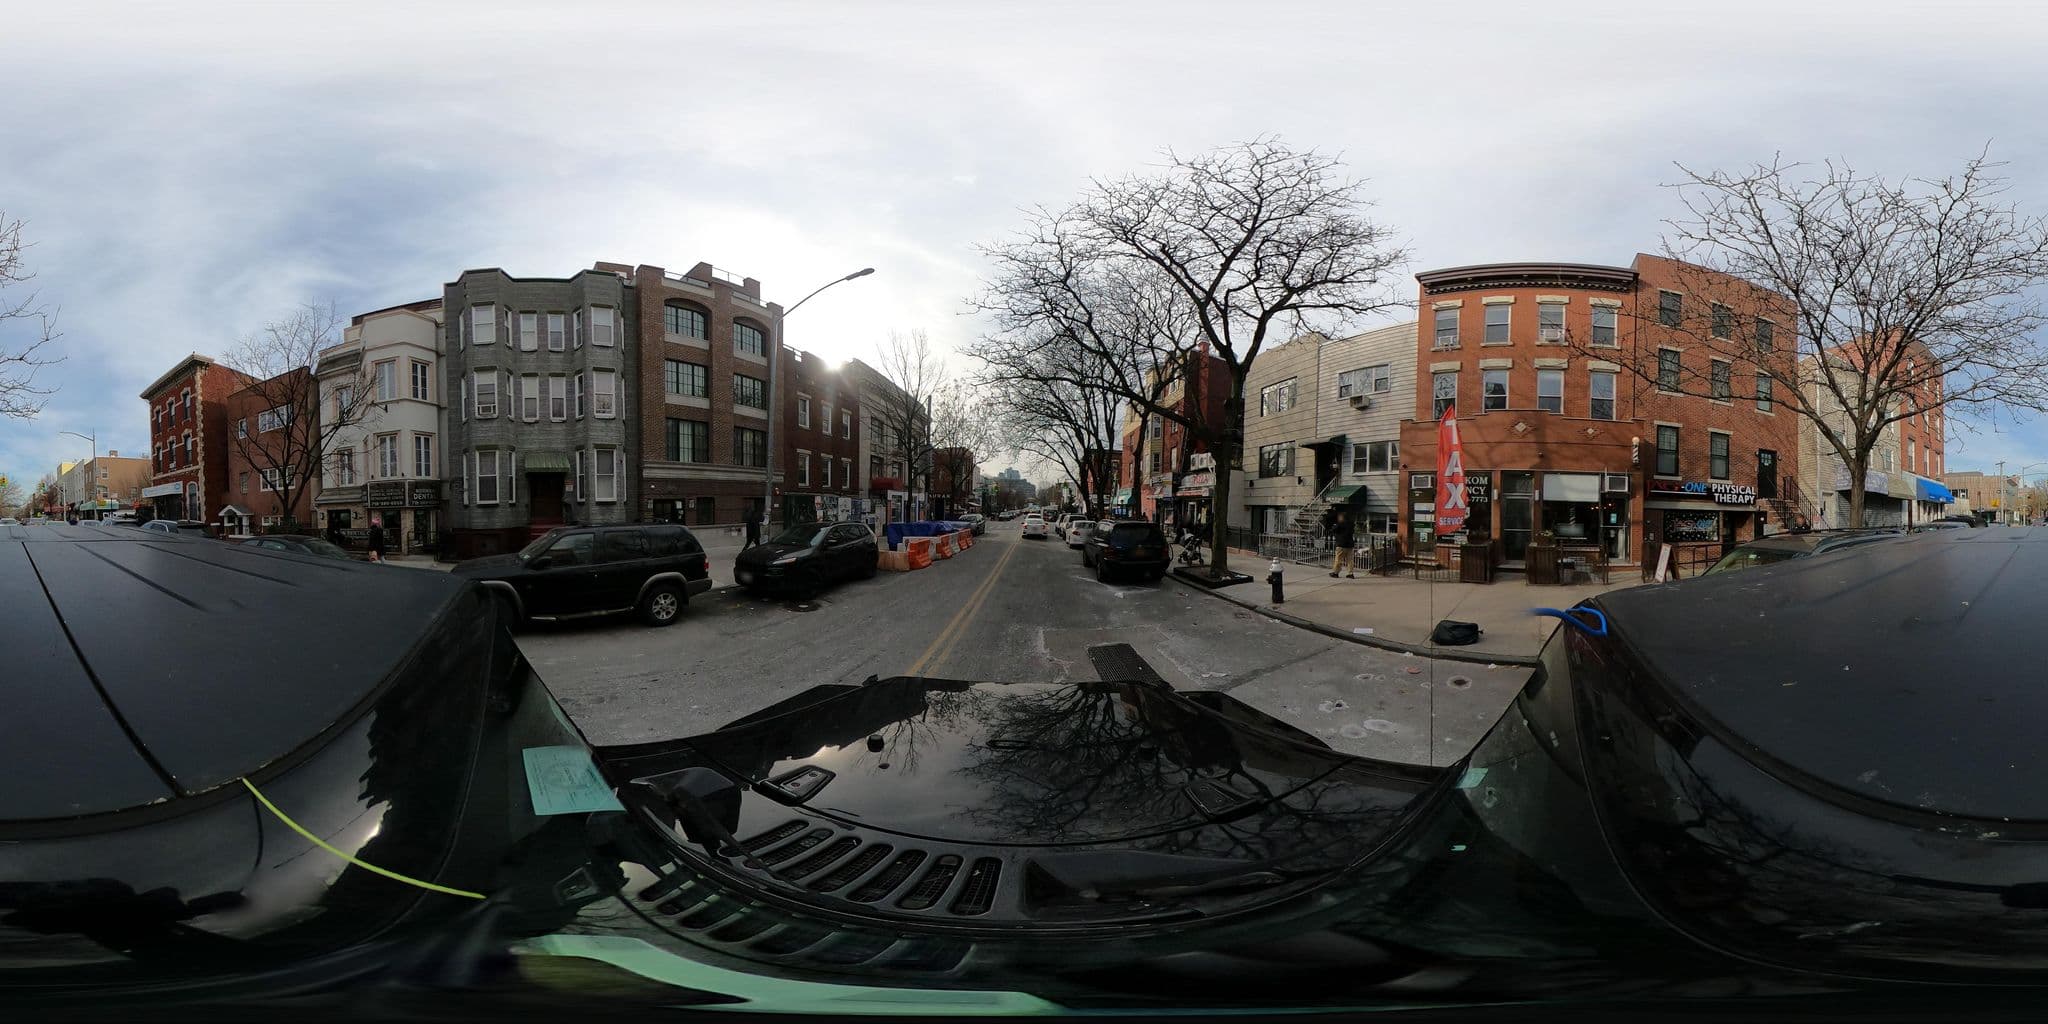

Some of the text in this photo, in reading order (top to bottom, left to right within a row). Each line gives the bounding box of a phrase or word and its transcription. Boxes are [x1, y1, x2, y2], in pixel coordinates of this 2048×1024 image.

[1445, 419, 1466, 508] TAX
[1711, 483, 1756, 495] PHYSICAL
[1713, 493, 1755, 504] THERAPY
[1439, 516, 1464, 526] SERVICE
